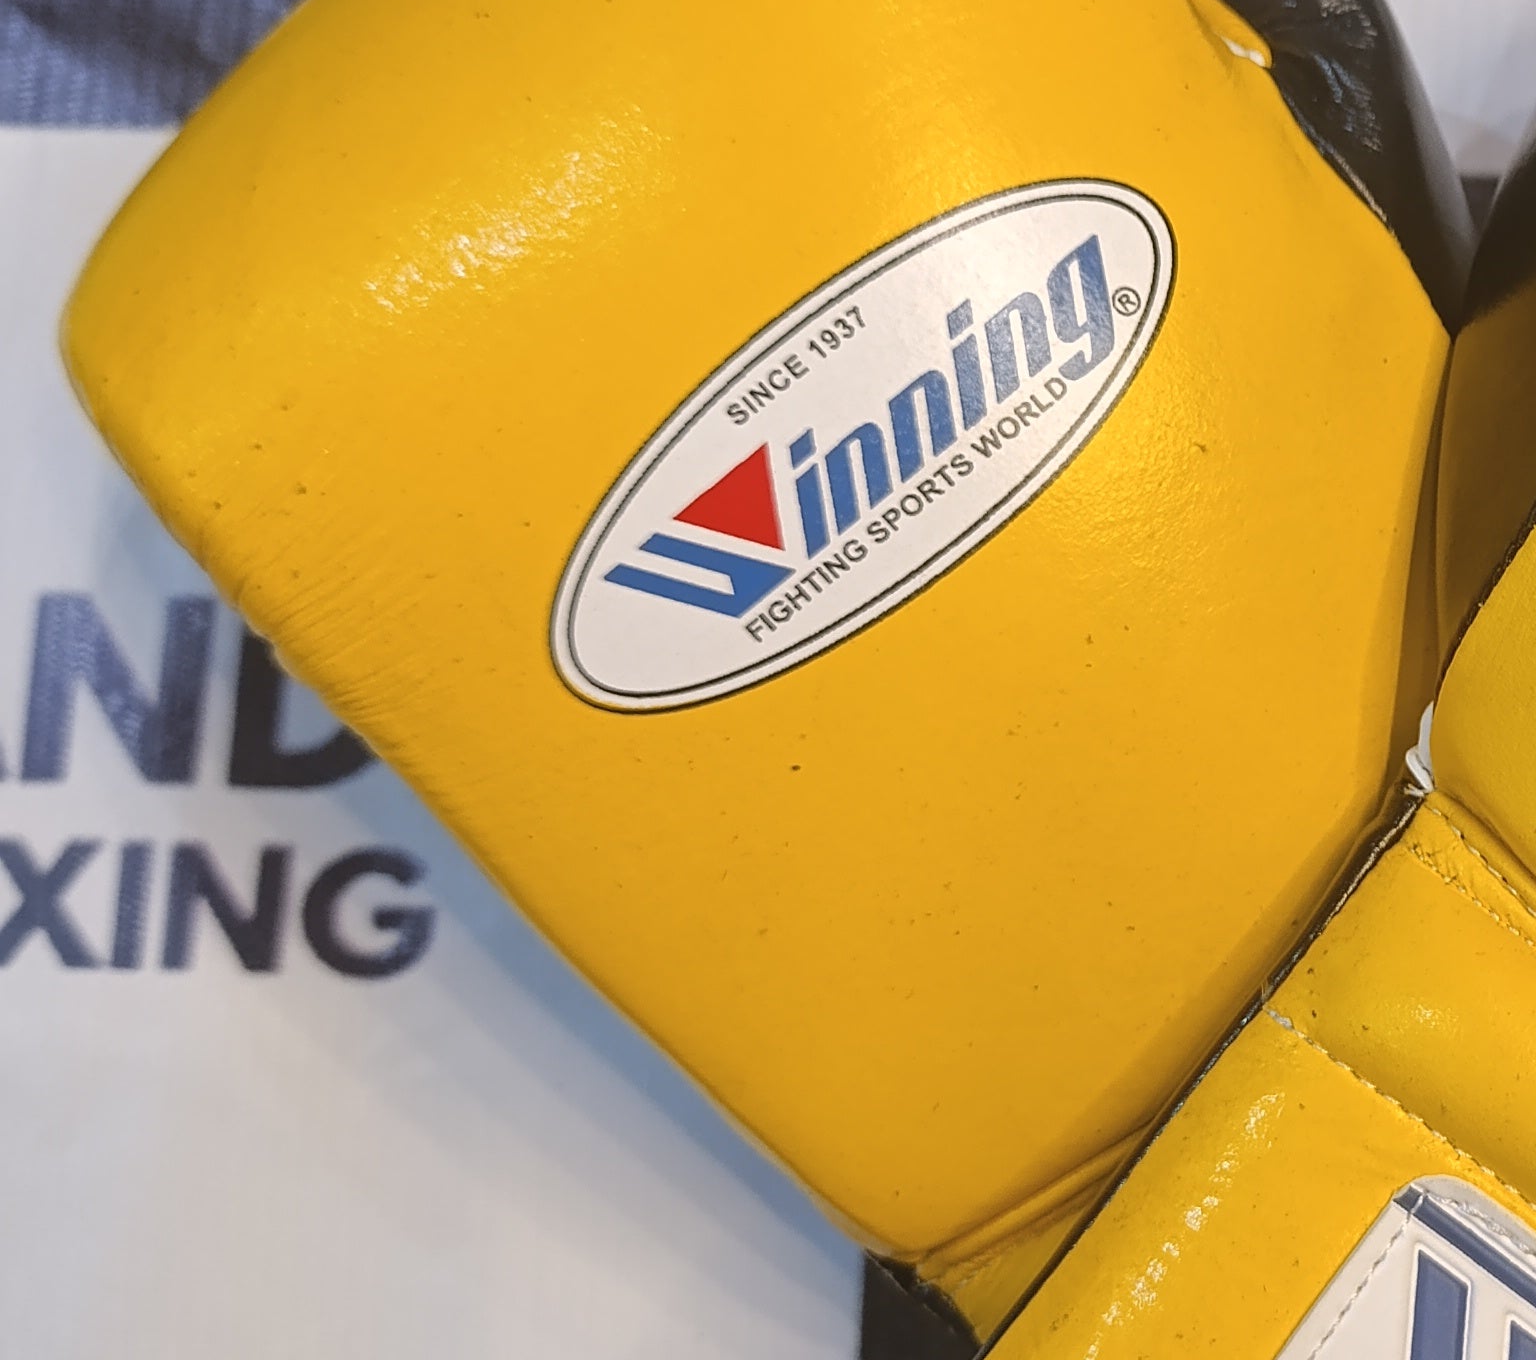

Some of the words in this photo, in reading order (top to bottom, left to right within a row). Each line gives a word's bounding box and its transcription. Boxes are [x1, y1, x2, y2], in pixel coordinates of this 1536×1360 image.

[604, 234, 1116, 618] Winning
[727, 356, 810, 426] SINCE
[808, 307, 868, 359] 1937
[745, 538, 869, 643] FIGHTING
[867, 454, 975, 544] SPORTS
[971, 376, 1068, 462] WORLD
[0, 593, 383, 788] ND
[0, 836, 435, 980] XING
